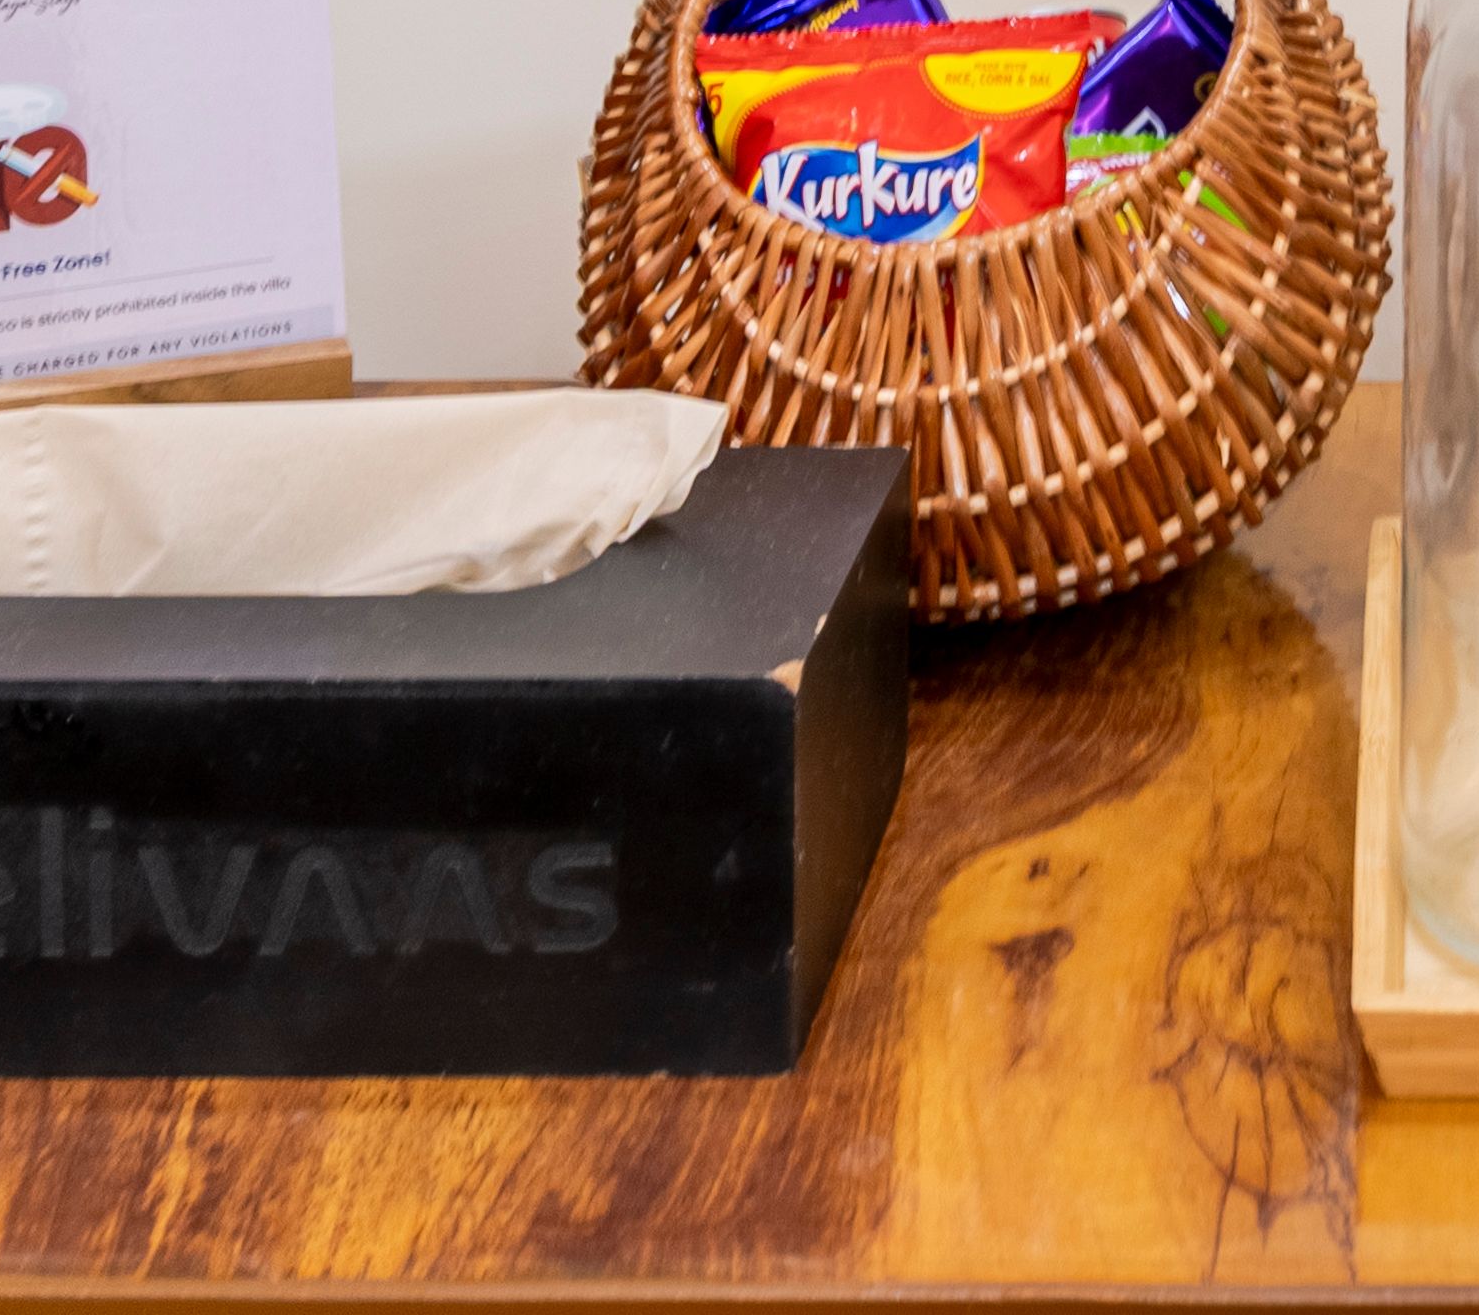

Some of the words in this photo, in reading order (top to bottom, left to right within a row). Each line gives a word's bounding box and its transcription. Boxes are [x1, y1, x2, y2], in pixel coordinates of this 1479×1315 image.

[761, 139, 979, 232] Kurkure
[21, 314, 33, 329] is
[37, 306, 91, 329] strictly
[95, 293, 177, 322] prohibited
[181, 286, 227, 306] inside
[231, 282, 257, 299] the
[260, 276, 291, 293] villa
[12, 352, 99, 378] CHARGED
[107, 347, 139, 363] FOR
[148, 339, 183, 357] ANY
[190, 321, 293, 350] VIOLATIONS
